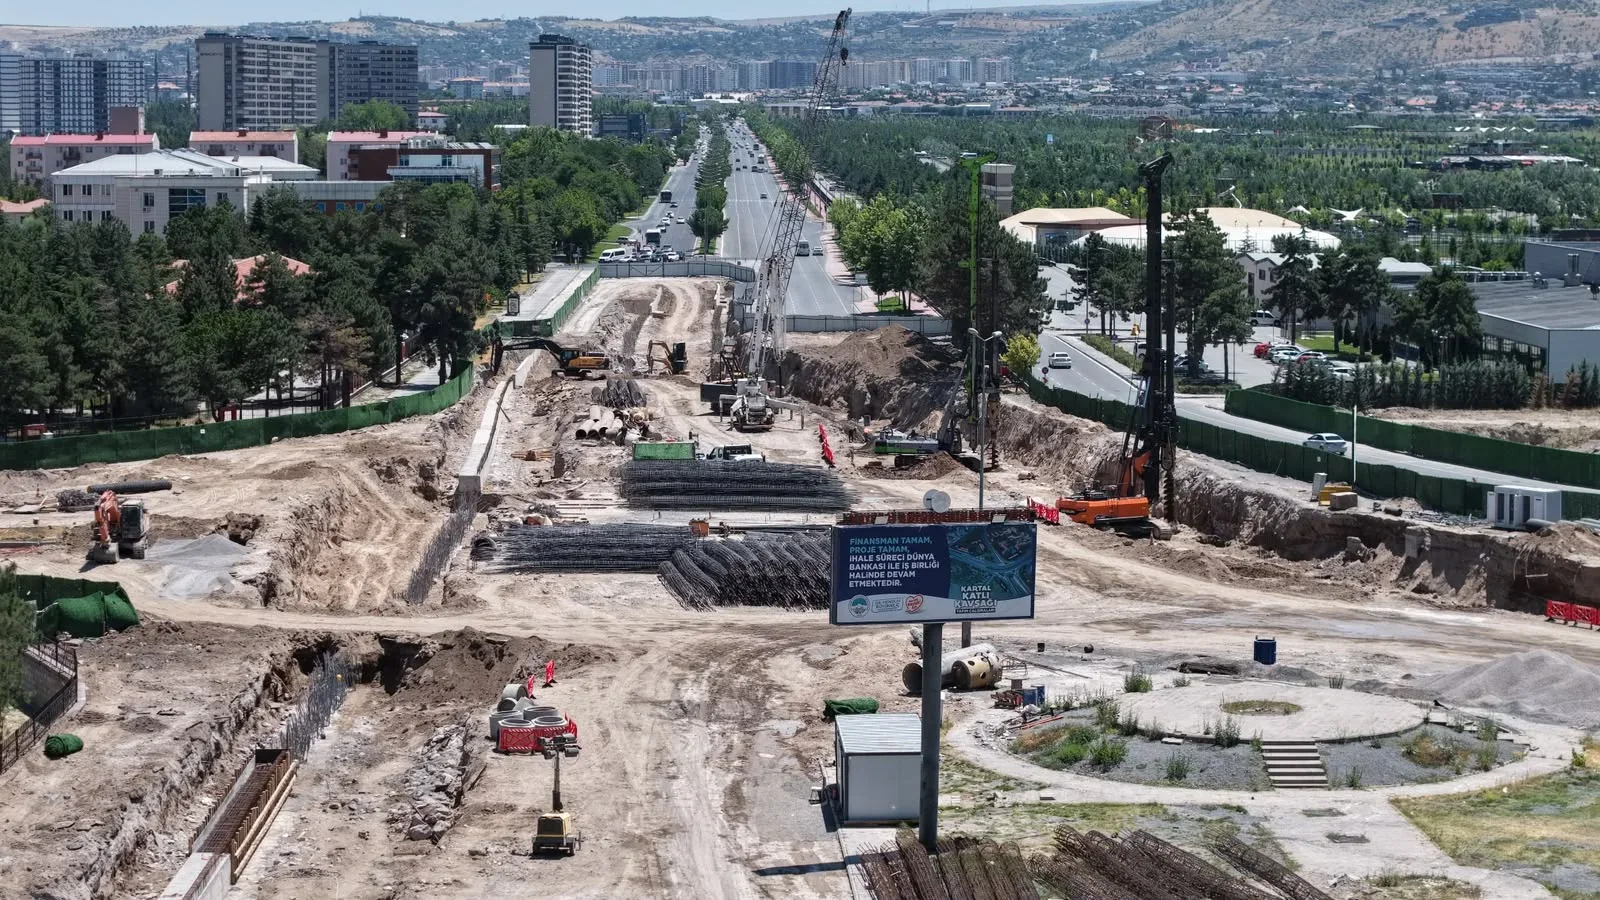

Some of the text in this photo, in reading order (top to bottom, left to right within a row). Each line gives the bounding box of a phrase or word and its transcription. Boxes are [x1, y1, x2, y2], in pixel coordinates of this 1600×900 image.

[849, 536, 933, 545] FİNANSMAN TAMAM,
[878, 545, 910, 553] TAMAM,
[849, 552, 935, 562] İHALE SÜRECİ DÜNYA
[901, 562, 909, 570] İŞ
[911, 560, 940, 569] BİRLİĞİ
[849, 571, 885, 579] HALİNDE
[848, 579, 903, 588] ETMEKTEDİR.
[962, 592, 990, 600] KATLI
[954, 599, 997, 608] KAVŞAĞI
